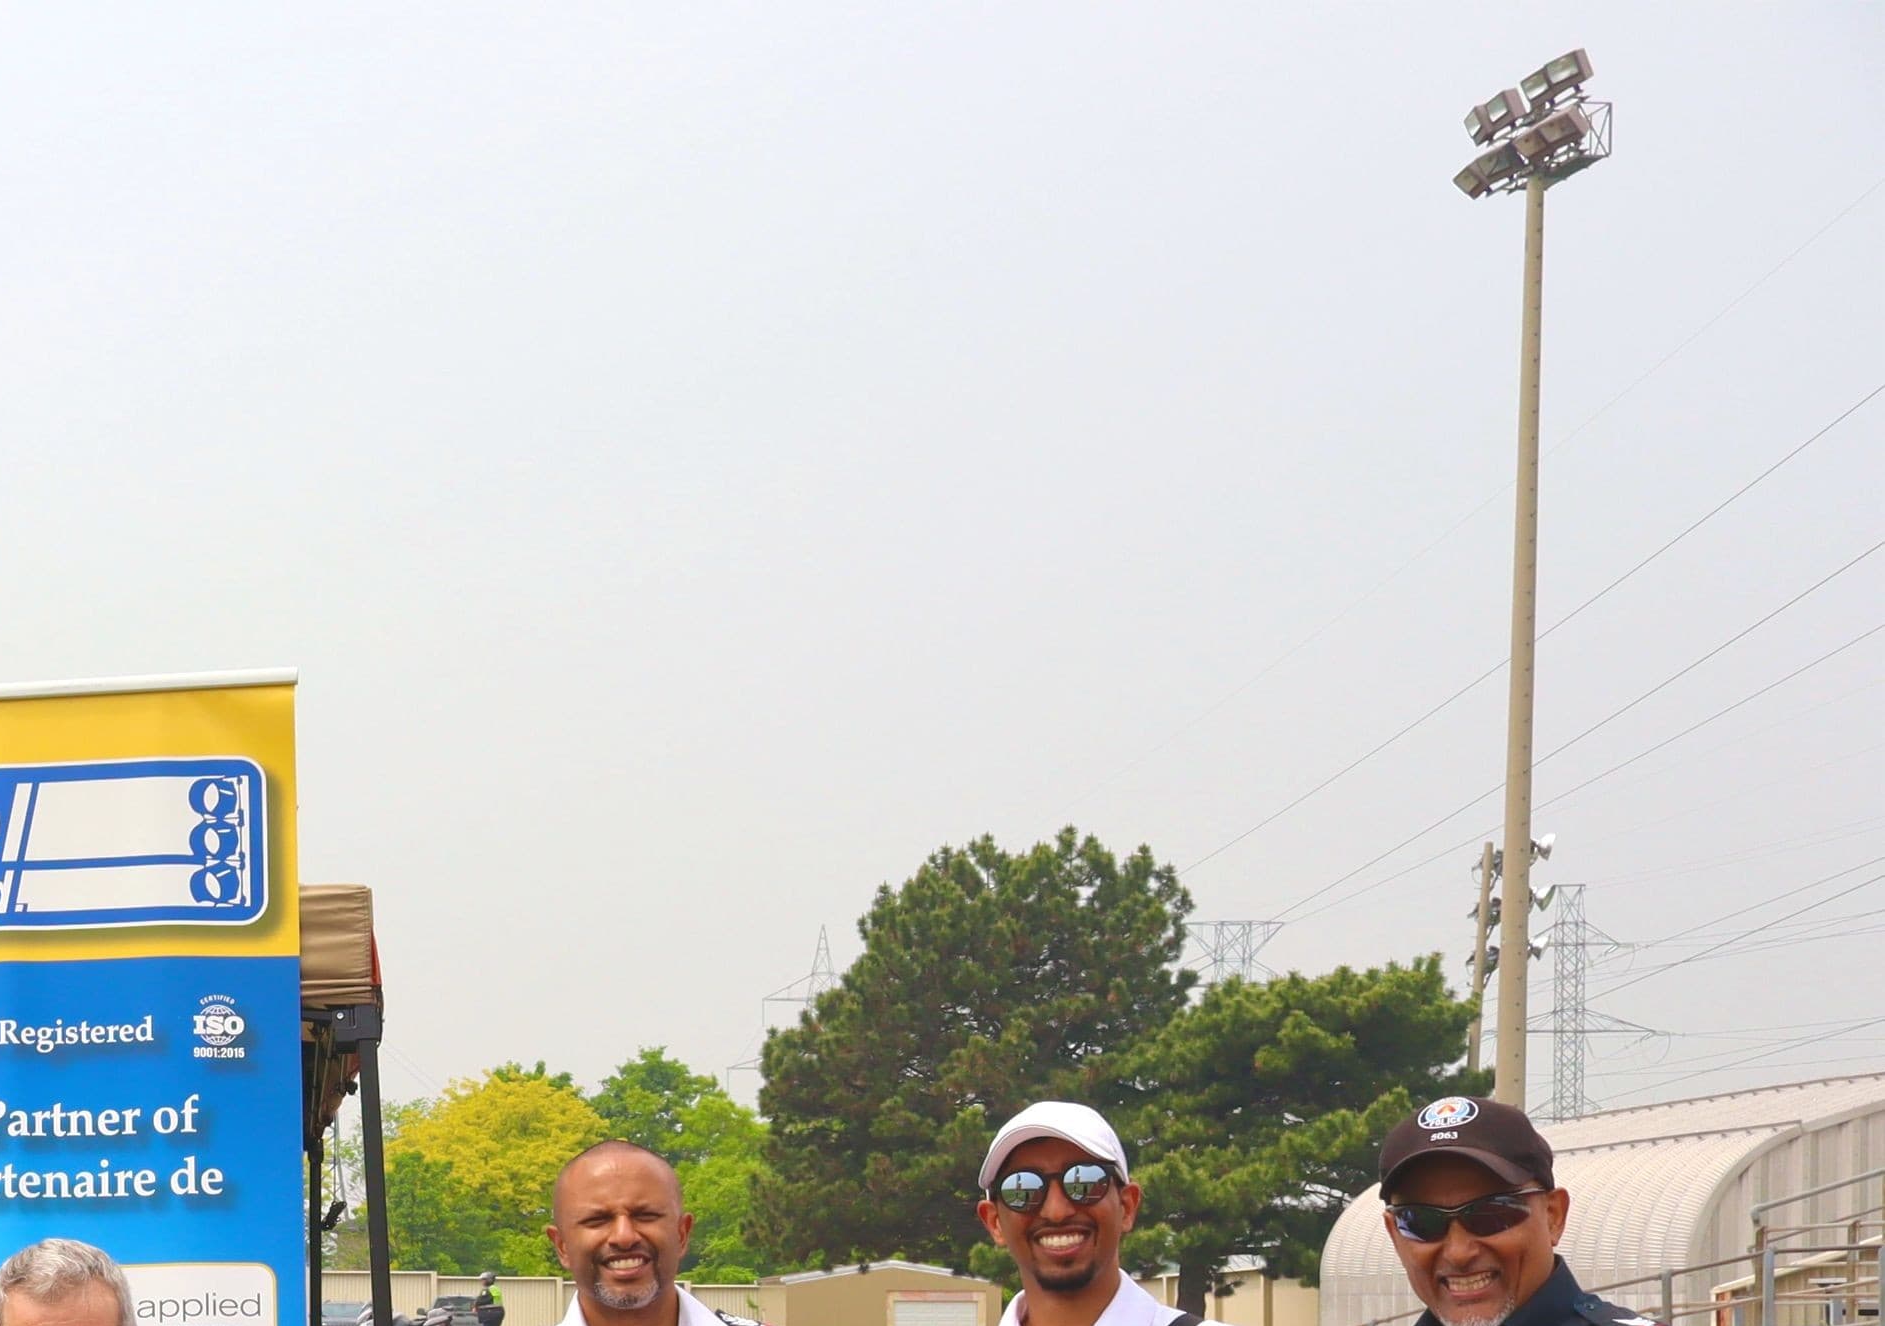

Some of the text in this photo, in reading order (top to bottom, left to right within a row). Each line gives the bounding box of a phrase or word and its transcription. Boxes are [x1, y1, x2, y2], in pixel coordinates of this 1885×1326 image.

[199, 994, 235, 1006] CERTIFIED
[193, 1015, 245, 1035] ISO
[194, 1046, 245, 1058] 9001:2015
[152, 1094, 201, 1134] of
[168, 1157, 224, 1197] de
[137, 1292, 261, 1323] applied
